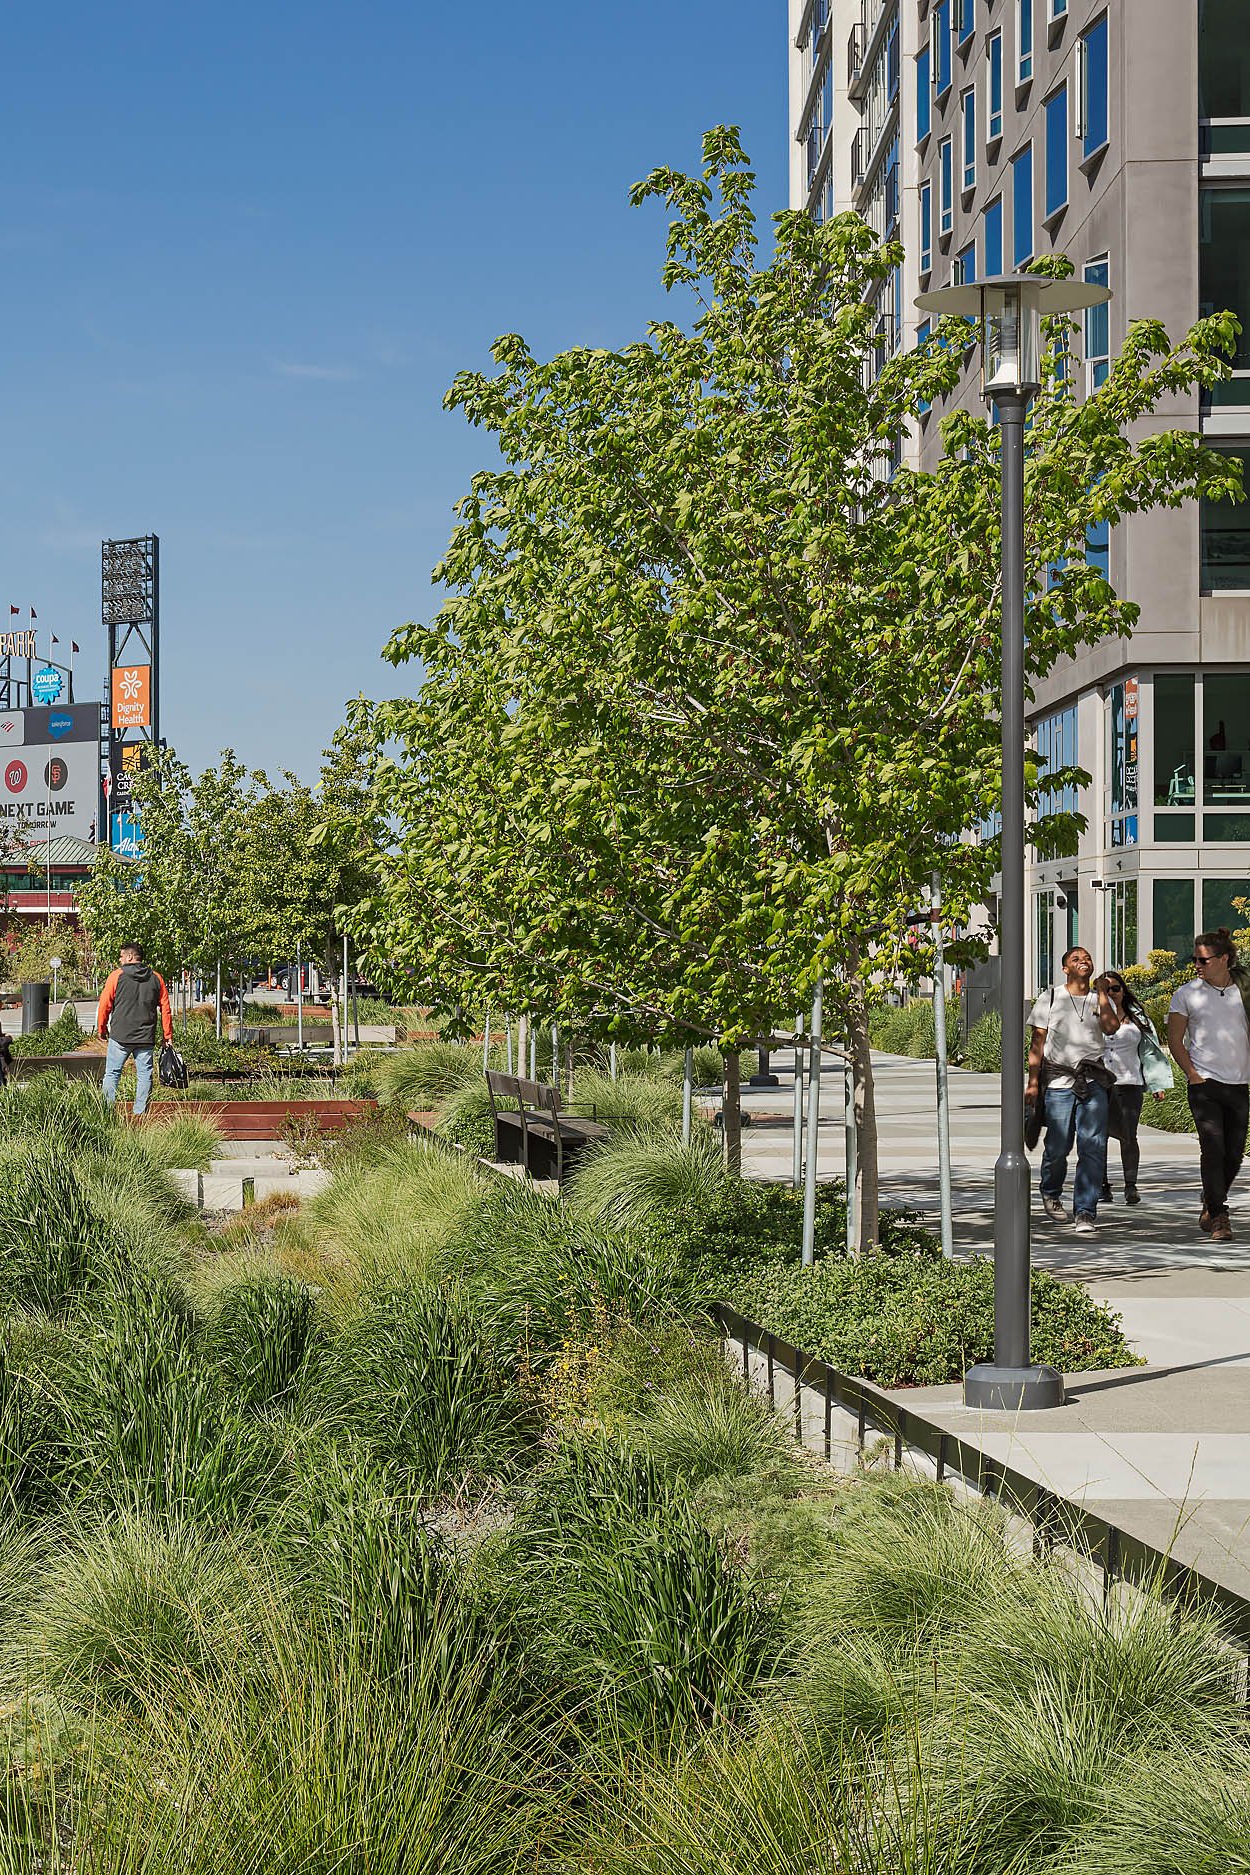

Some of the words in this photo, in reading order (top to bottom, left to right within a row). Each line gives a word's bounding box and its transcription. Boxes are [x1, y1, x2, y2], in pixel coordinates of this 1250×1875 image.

[36, 674, 60, 685] coupa
[117, 702, 145, 715] Dignity
[37, 801, 75, 816] GAME
[17, 820, 57, 829] TOORROW
